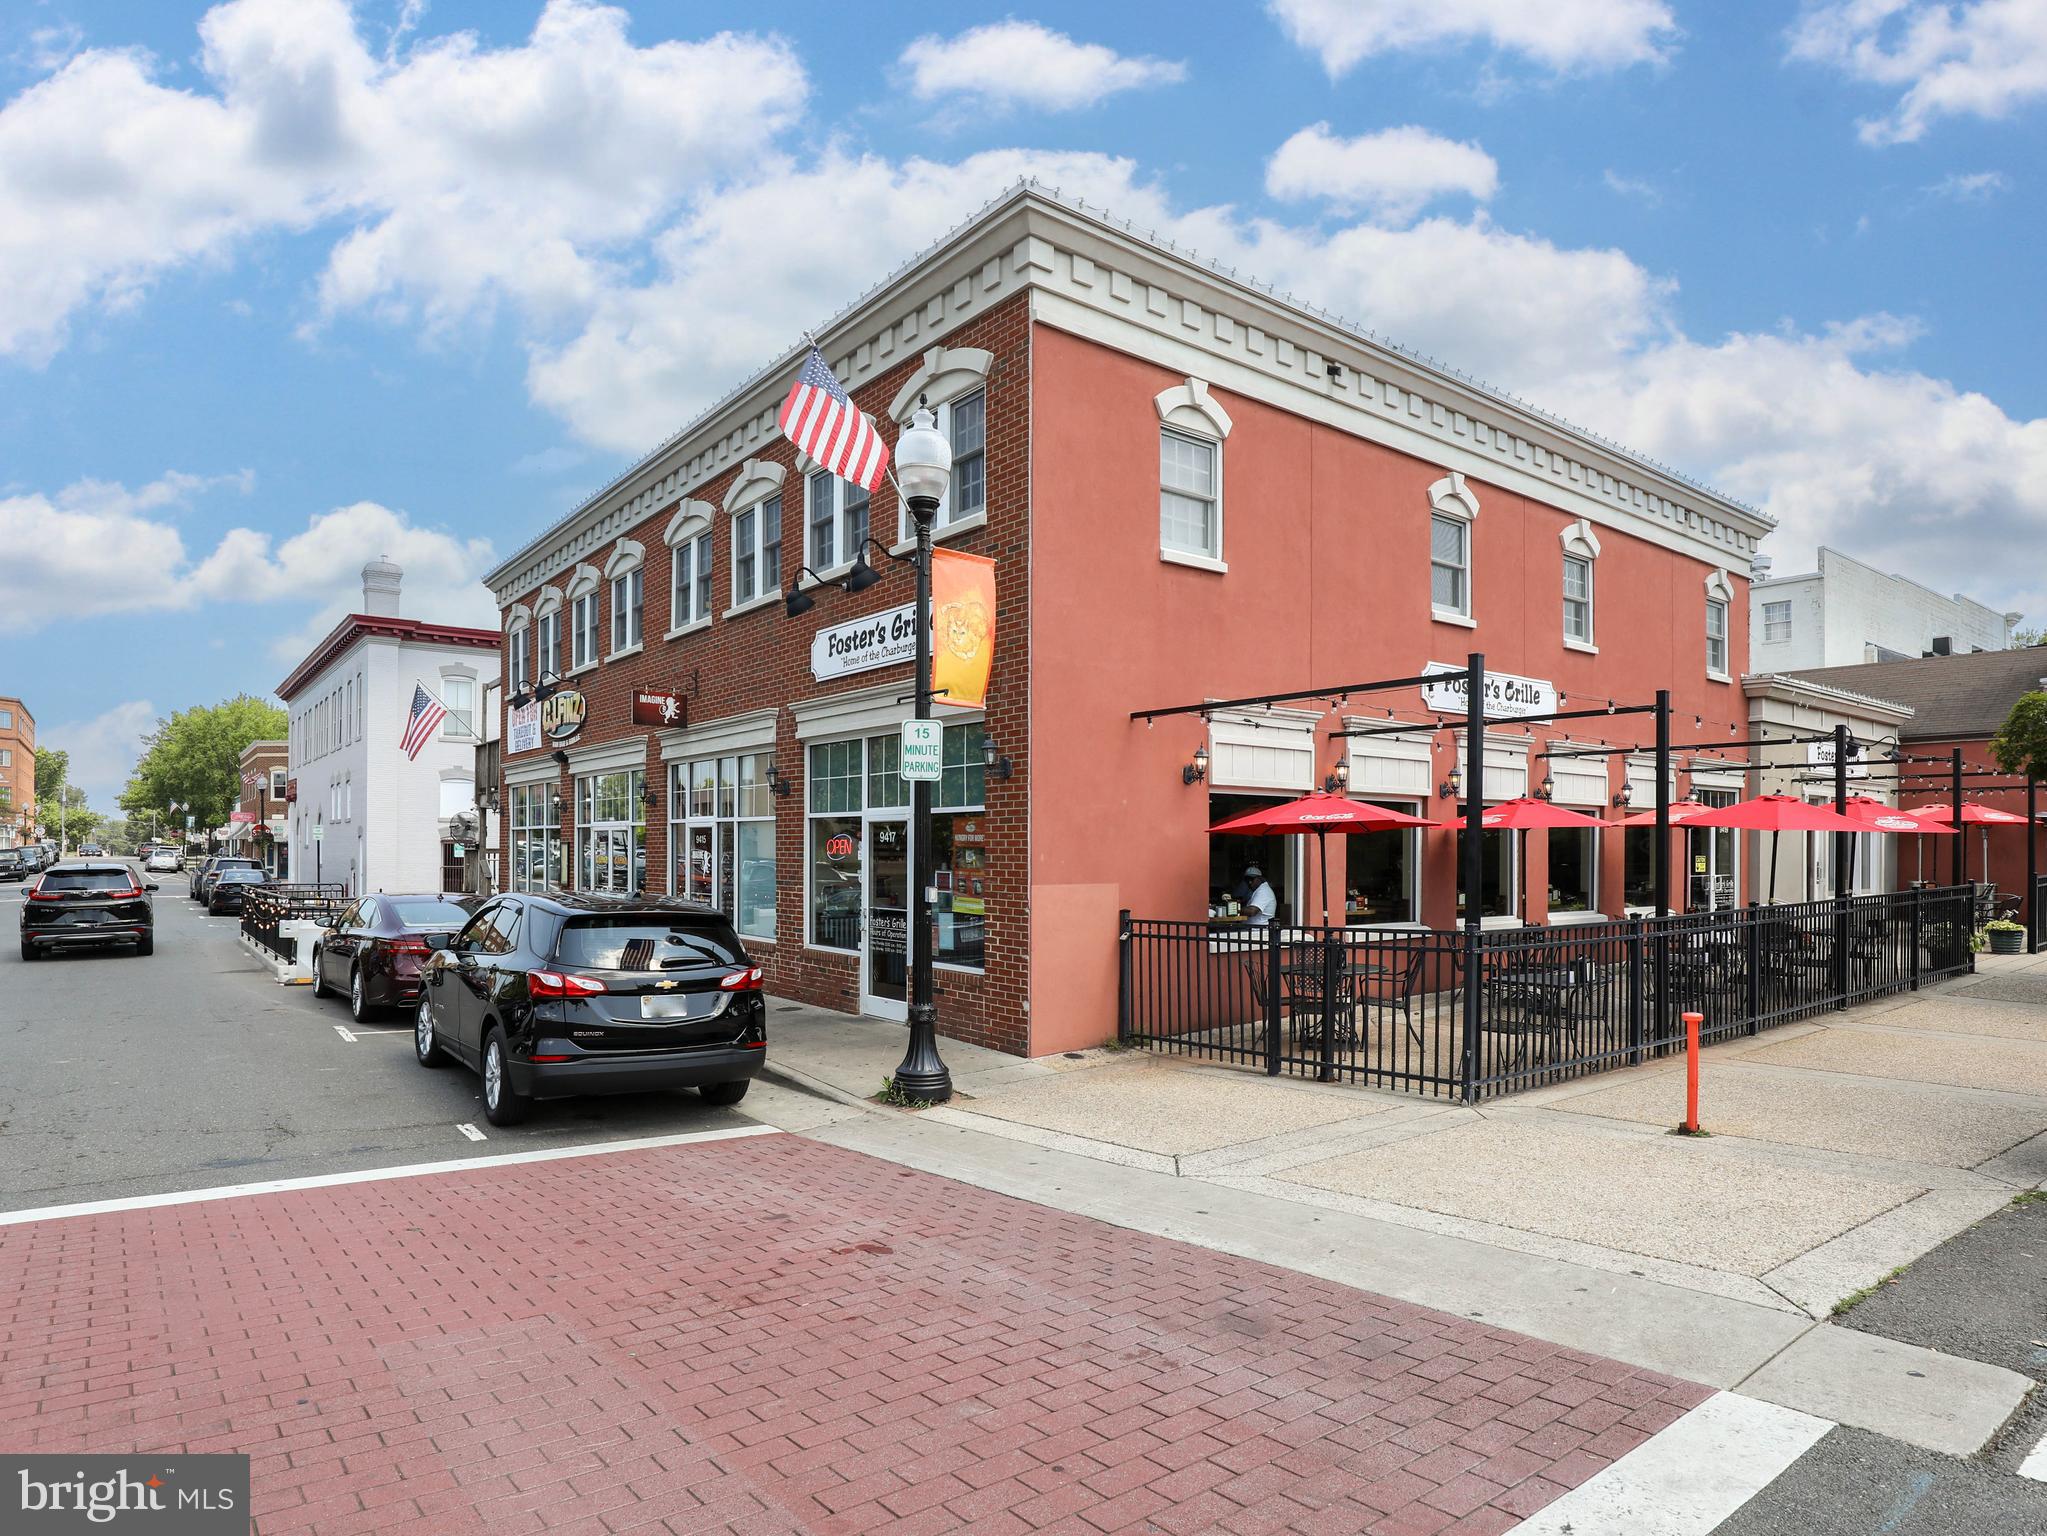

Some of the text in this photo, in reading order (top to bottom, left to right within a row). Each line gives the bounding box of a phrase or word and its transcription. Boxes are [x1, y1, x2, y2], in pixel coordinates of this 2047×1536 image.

[828, 609, 934, 658] Foster's Gri
[861, 652, 869, 663] of
[869, 649, 880, 660] the
[881, 641, 917, 659] Charburge
[1444, 679, 1501, 700] Fosr's
[639, 694, 666, 705] IMAGINE
[1486, 702, 1496, 710] the
[914, 728, 930, 739] 15
[905, 744, 939, 756] MINUTE
[904, 761, 939, 773] PARKING
[695, 835, 707, 843] 9415
[879, 831, 896, 843] 9417
[967, 834, 975, 842] FOR
[826, 839, 852, 855] OPEN
[870, 915, 907, 929] Foster's Grille
